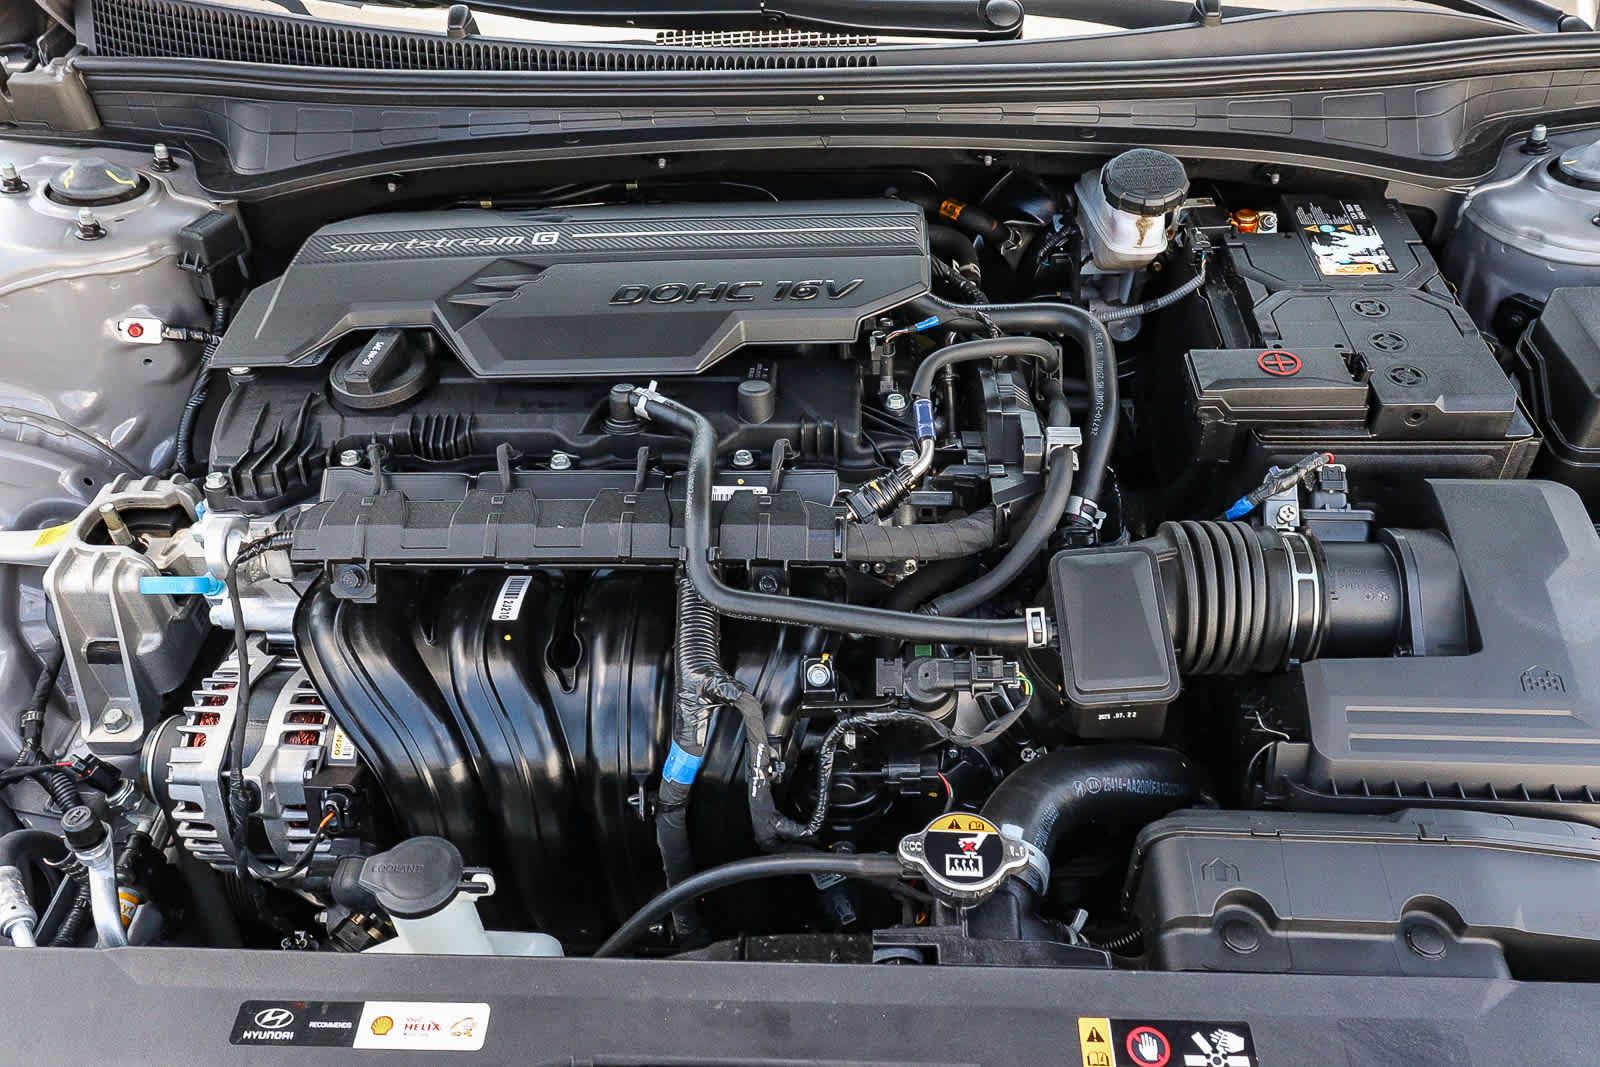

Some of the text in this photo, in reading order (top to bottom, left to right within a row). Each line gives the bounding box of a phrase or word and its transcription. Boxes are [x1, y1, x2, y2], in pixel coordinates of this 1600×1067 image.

[323, 236, 524, 254] Smartstream
[608, 279, 864, 305] DOHC 16V
[404, 1022, 441, 1032] HELIX
[243, 1031, 294, 1040] HYUNDAI
